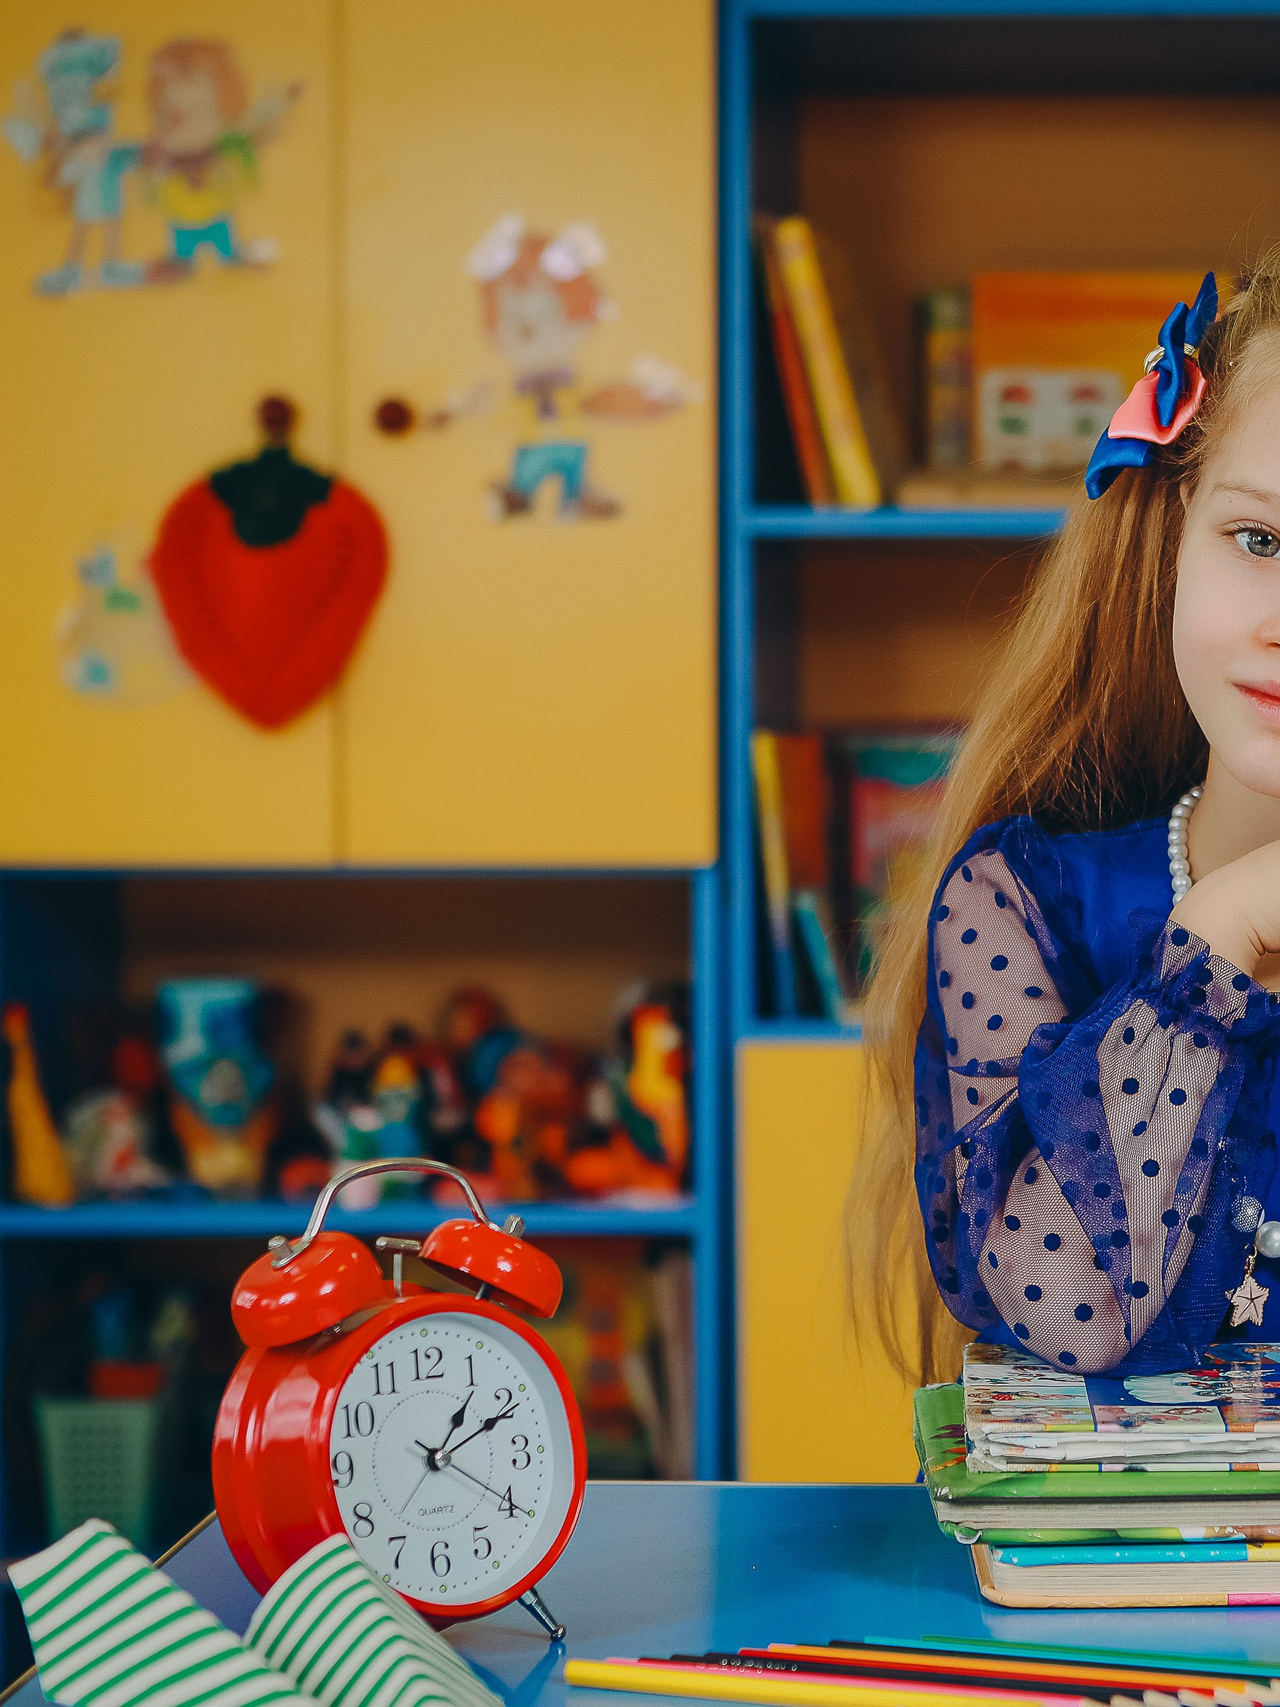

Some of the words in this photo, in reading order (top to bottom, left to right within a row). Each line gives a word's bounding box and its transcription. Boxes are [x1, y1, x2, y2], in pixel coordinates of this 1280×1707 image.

[371, 1361, 401, 1396] 11
[410, 1346, 445, 1381] 12
[465, 1354, 478, 1387] 1
[342, 1401, 375, 1439] 10
[494, 1388, 516, 1418] 2
[333, 1451, 355, 1488] 9
[511, 1435, 531, 1470] 3
[418, 1505, 455, 1517] QUARTZ
[498, 1485, 518, 1519] 4
[352, 1502, 374, 1538] 8
[387, 1535, 407, 1569] 7
[430, 1541, 451, 1577] 6
[473, 1526, 493, 1561] 5
